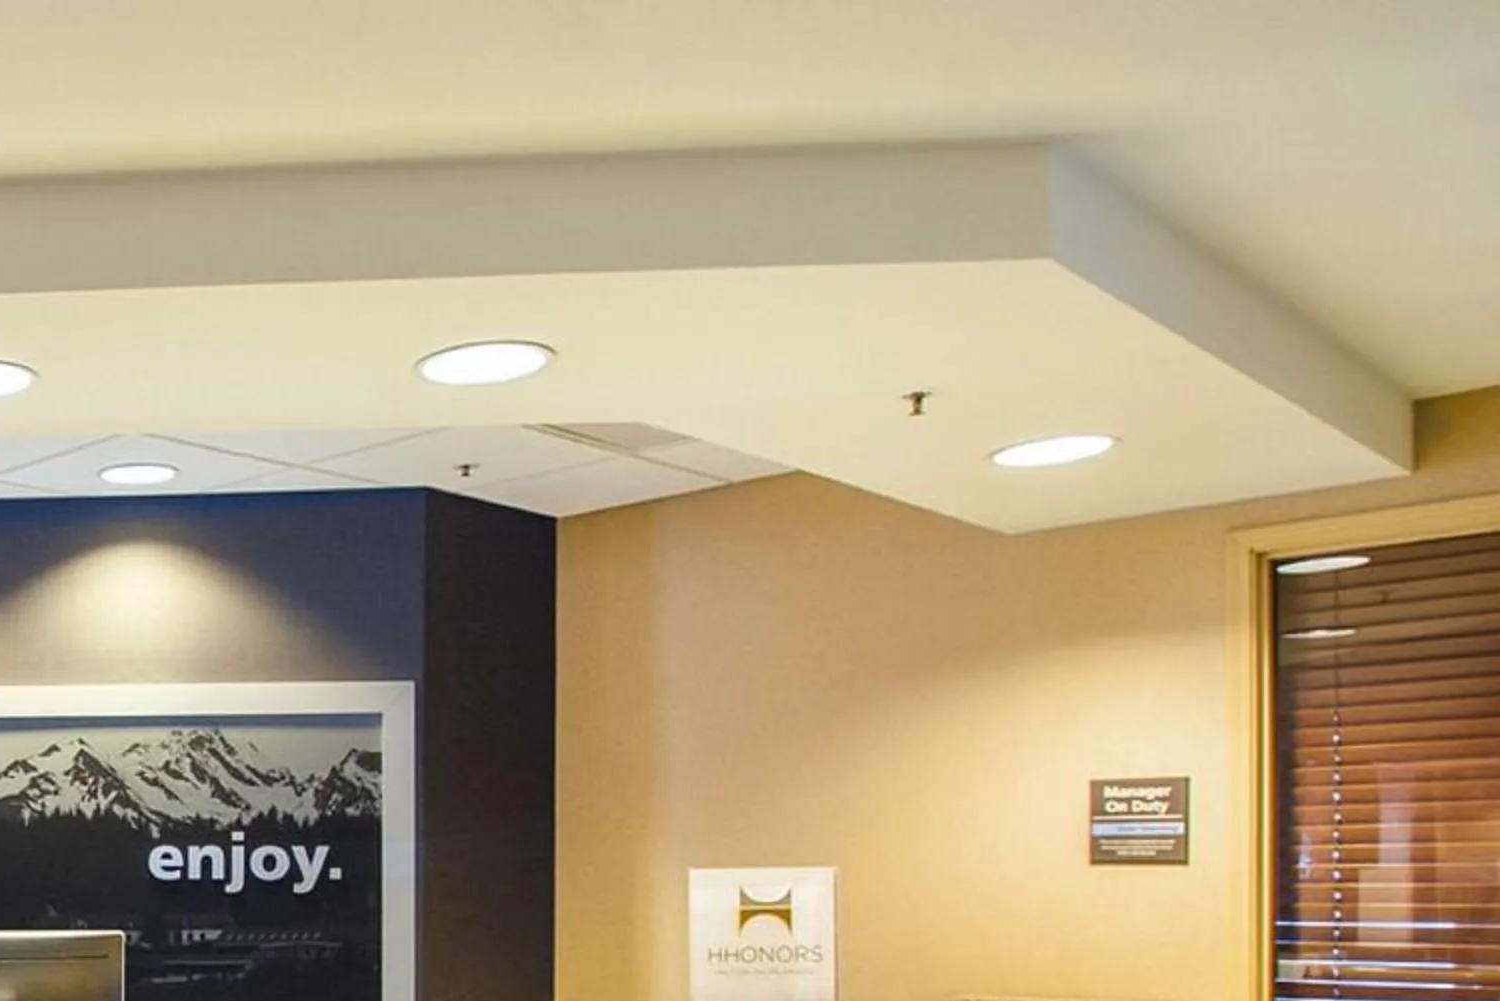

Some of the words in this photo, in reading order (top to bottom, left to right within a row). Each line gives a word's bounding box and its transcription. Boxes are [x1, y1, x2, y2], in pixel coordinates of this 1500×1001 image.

[1103, 785, 1172, 800] Manager
[1105, 800, 1128, 813] On
[1131, 800, 1170, 815] Duty
[148, 831, 342, 893] enjoy.
[707, 944, 824, 964] HHONORS
